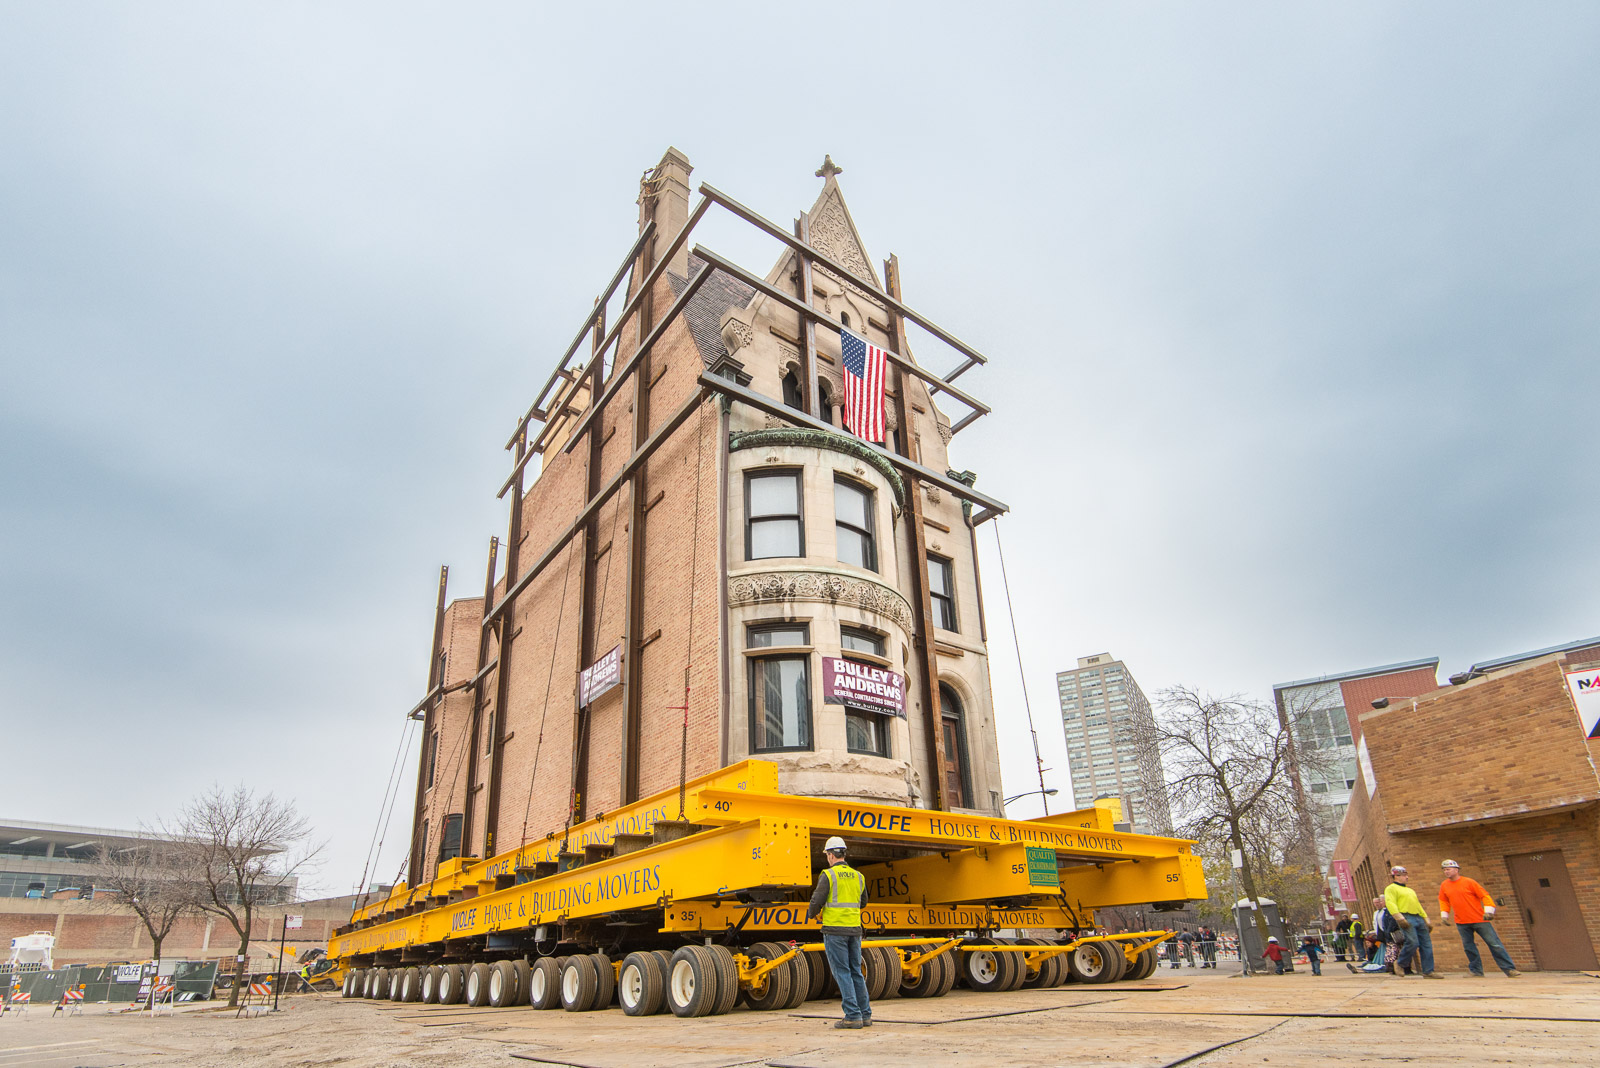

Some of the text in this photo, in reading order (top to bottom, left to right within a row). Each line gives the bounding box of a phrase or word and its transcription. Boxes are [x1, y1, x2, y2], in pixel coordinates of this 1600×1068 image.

[611, 650, 617, 661] &
[833, 659, 900, 688] BULLEY &
[834, 673, 901, 701] ANDREWS
[854, 692, 884, 705] CONTRACTORS
[847, 700, 896, 714] www.bulley.com
[714, 800, 733, 812] 40'
[837, 809, 1124, 852] WOLFE HOUSE & BUILDING MOVERS
[1028, 850, 1055, 861] QUALITY
[837, 871, 856, 879] WOLFE
[1011, 863, 1027, 875] 55'
[1165, 873, 1181, 883] 55'
[451, 864, 661, 932] WOLFE HOUSE & BUILDING MOVERS
[680, 911, 698, 922] 35'
[753, 908, 1045, 925] WOL OUSE & BUILDING MOVERS
[118, 965, 141, 977] WOLFE
